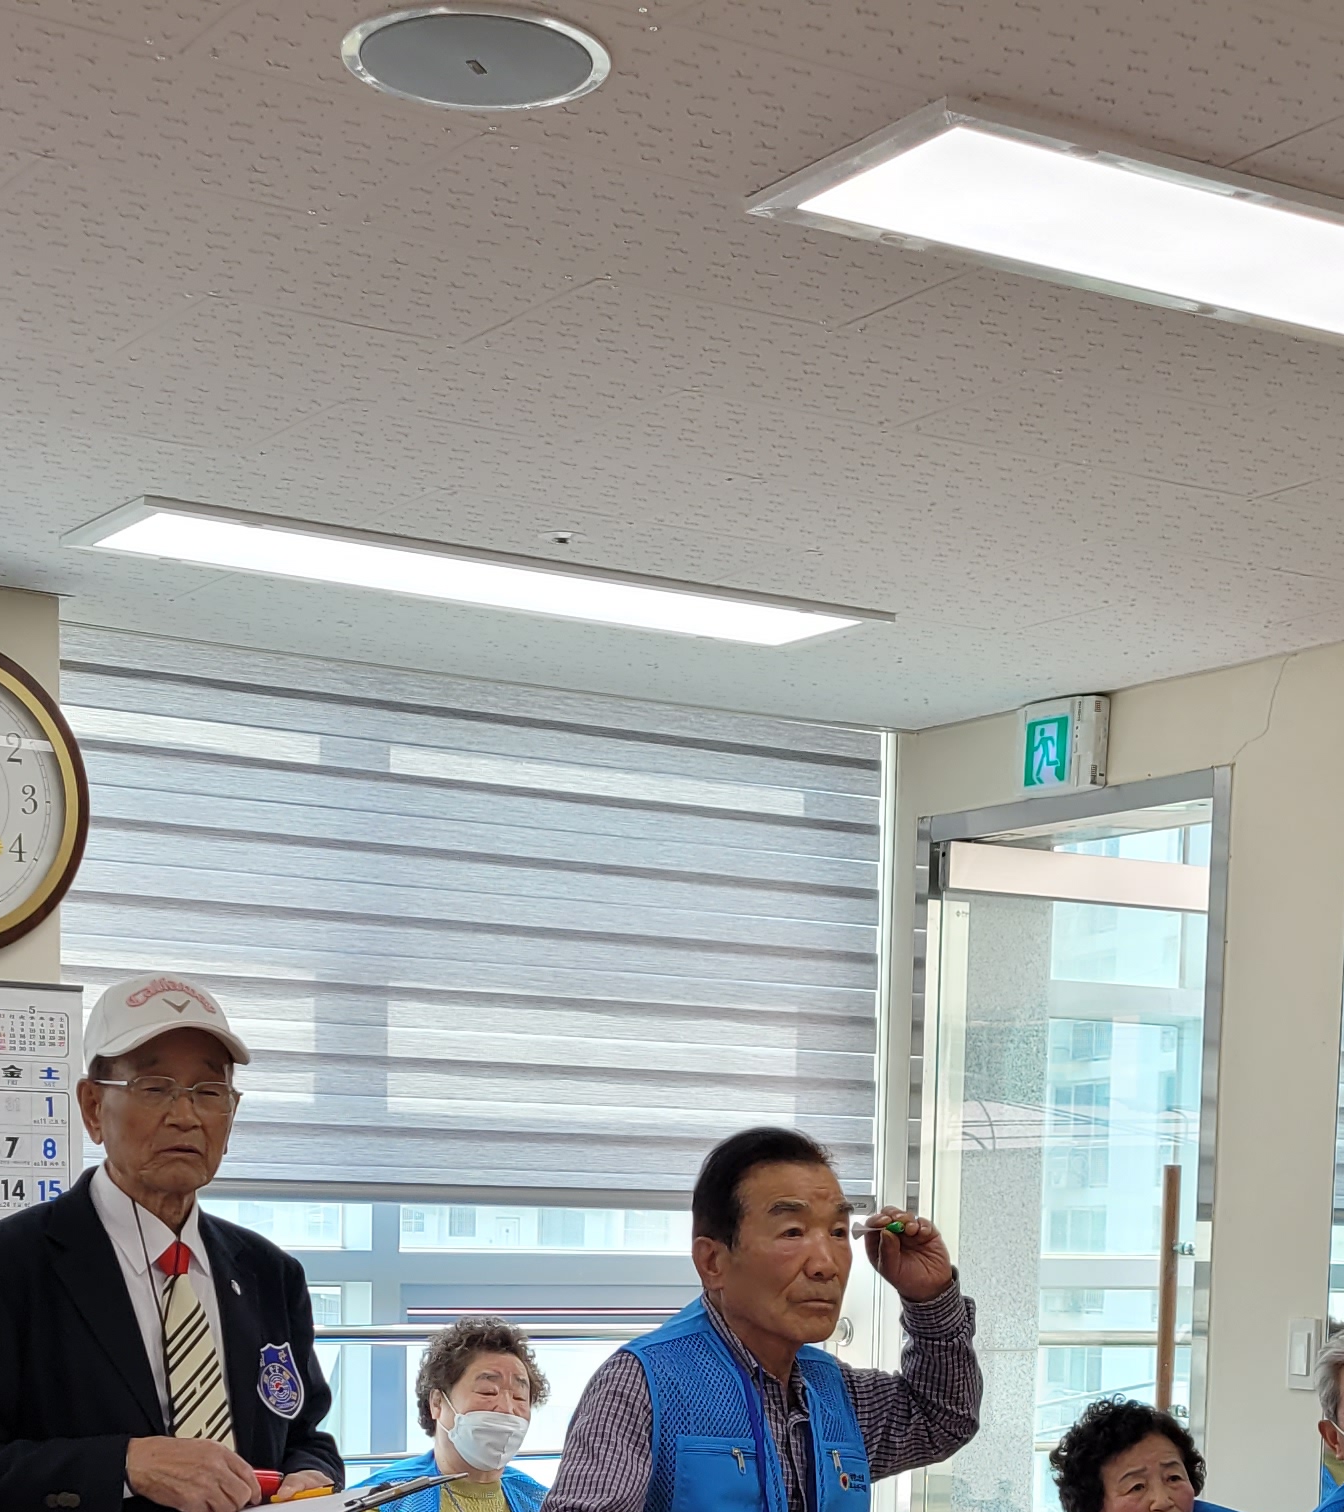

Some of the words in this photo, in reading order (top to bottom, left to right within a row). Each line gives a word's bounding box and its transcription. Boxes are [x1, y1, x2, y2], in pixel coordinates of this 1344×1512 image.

[6, 731, 23, 766] 2
[19, 783, 39, 816] 3
[7, 832, 28, 864] 4
[125, 977, 217, 1014] Callaway
[28, 1005, 36, 1015] 5
[1, 1064, 24, 1080] 金
[38, 1066, 60, 1081] 土
[44, 1096, 54, 1118] 1
[4, 1136, 20, 1159] 7
[42, 1137, 57, 1160] 8
[0, 1178, 26, 1201] 14
[37, 1179, 63, 1202] 15
